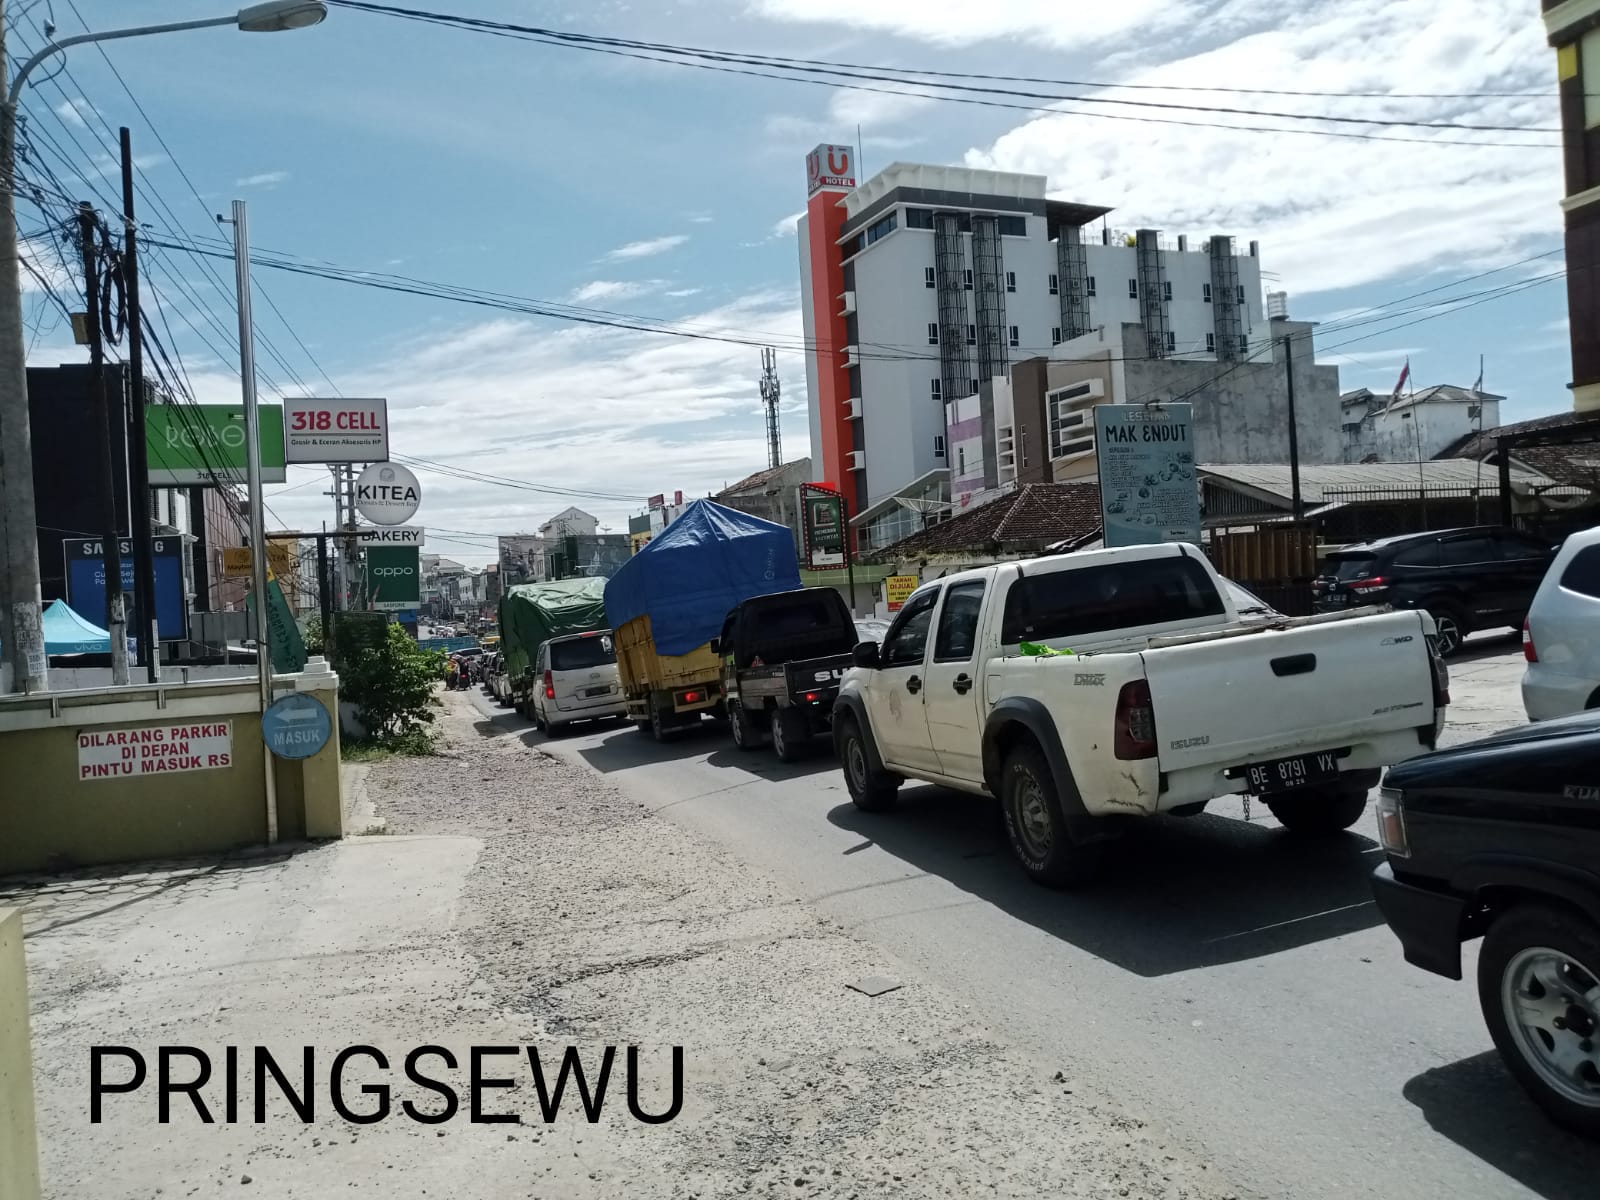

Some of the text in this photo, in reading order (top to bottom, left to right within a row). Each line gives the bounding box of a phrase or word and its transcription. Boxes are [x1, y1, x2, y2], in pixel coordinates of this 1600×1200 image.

[825, 177, 853, 186] HOTEL
[291, 411, 381, 430] 318 CELL
[1105, 424, 1187, 443] MAK ENDUT
[357, 485, 418, 501] KITEA
[83, 541, 164, 555] SASG
[74, 643, 102, 651] vivo
[79, 724, 228, 748] DILARANG PARKIR
[273, 729, 321, 745] MASUK
[1170, 735, 1210, 751] ISUZU
[121, 742, 190, 759] DI DEPAN
[81, 753, 231, 778] PINTU MASUK RS
[1250, 753, 1335, 785] BE 8791 VX
